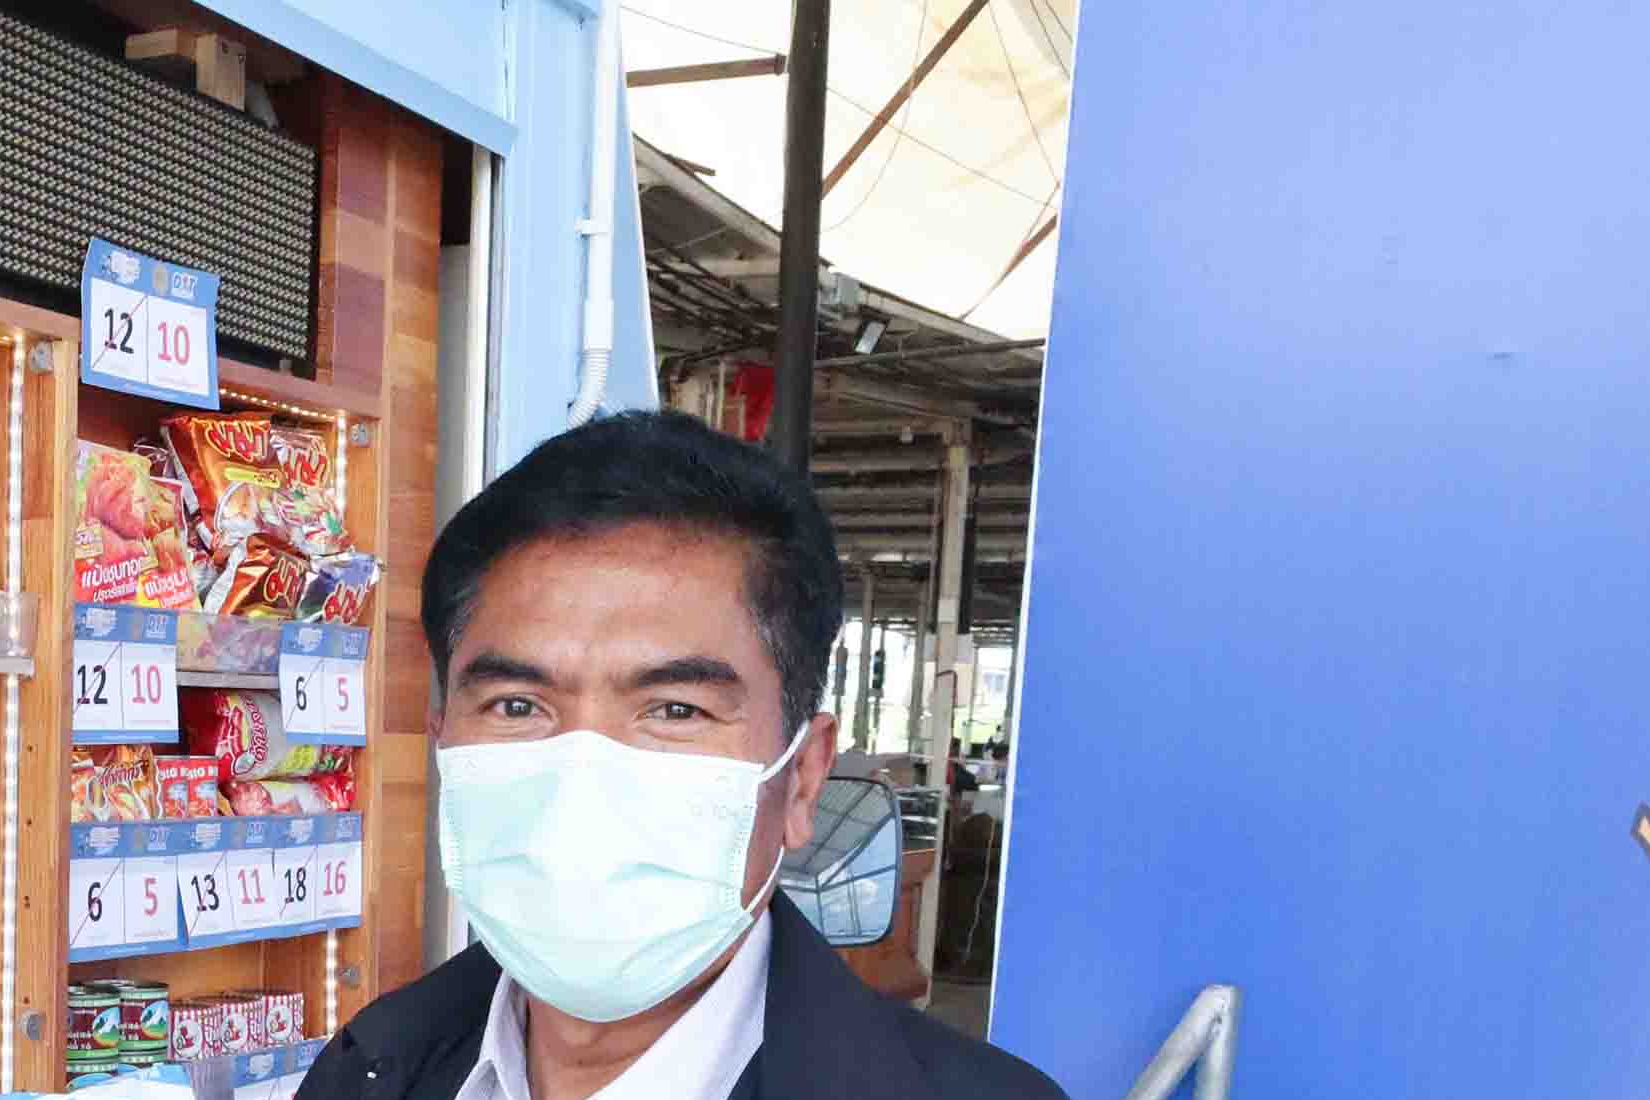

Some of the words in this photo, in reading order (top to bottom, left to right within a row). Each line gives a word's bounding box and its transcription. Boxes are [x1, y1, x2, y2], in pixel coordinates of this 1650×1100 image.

[104, 307, 135, 355] 12
[157, 322, 191, 367] 10
[77, 663, 109, 706] 12
[131, 664, 162, 705] 10
[295, 676, 308, 711] 6
[338, 677, 350, 712] 5
[87, 880, 103, 923] 6
[143, 877, 159, 917] 5
[190, 873, 221, 913] 13
[237, 867, 266, 906] 11
[284, 866, 307, 904] 18
[323, 860, 347, 897] 16
